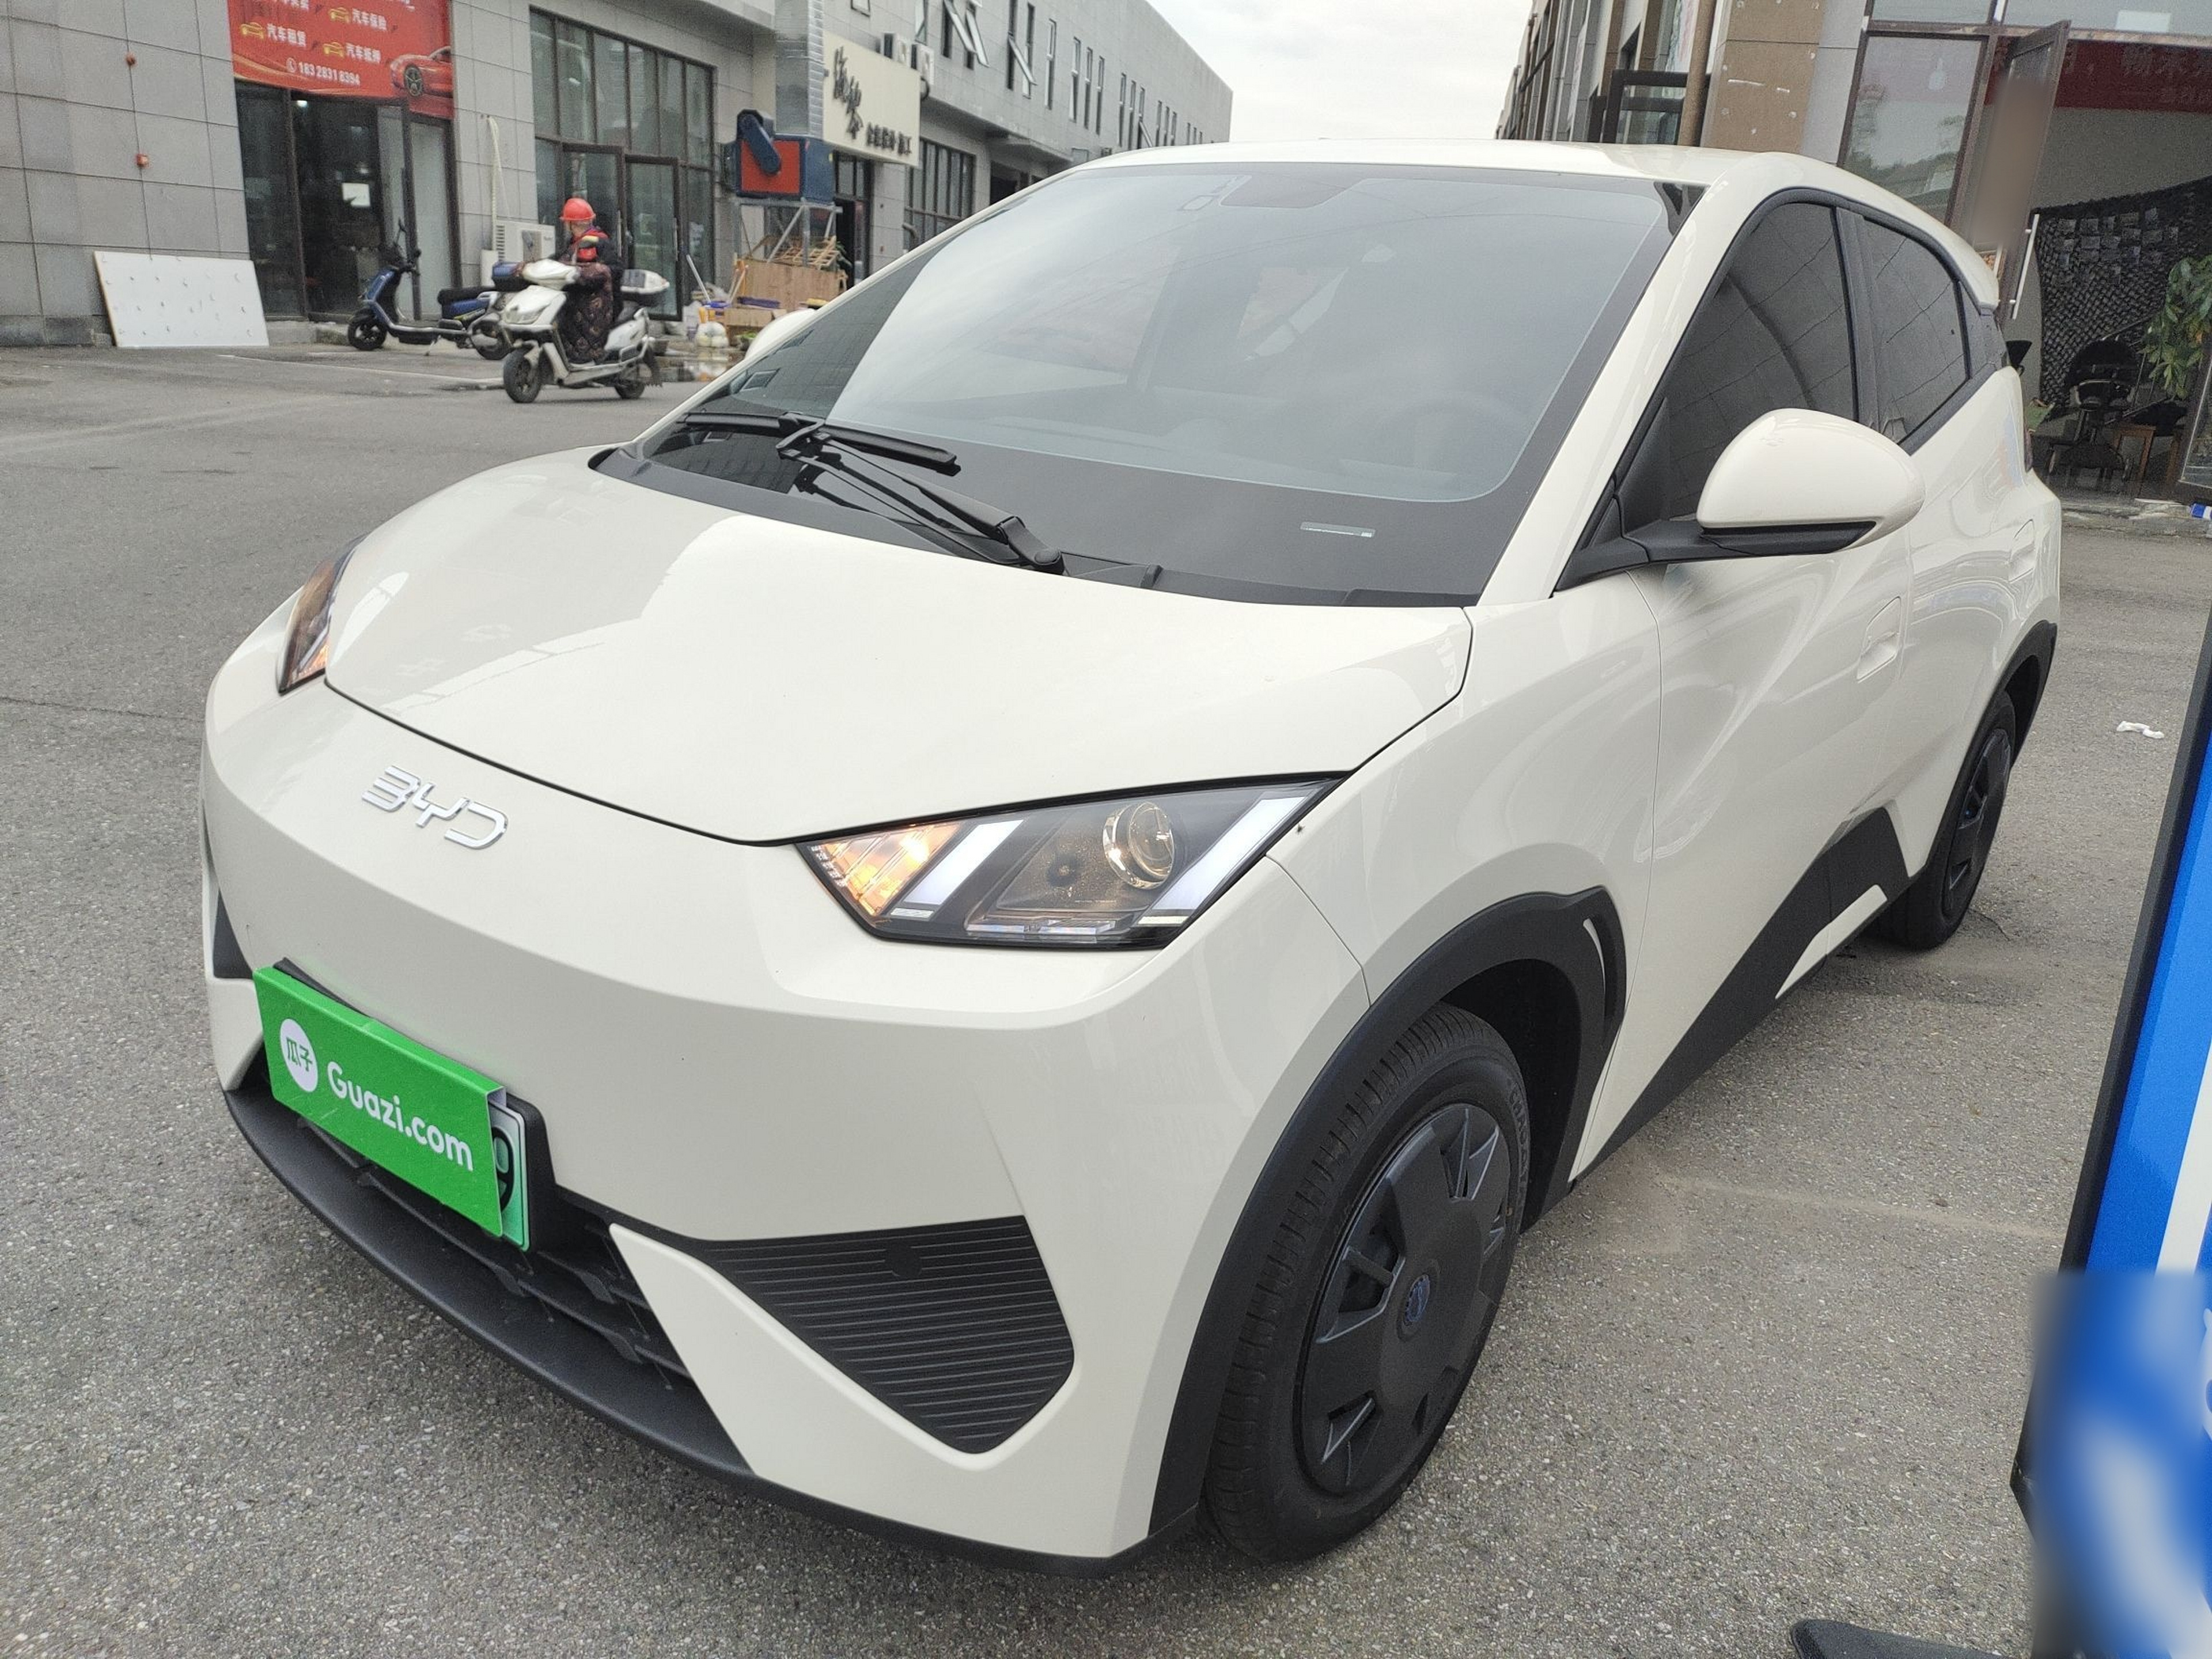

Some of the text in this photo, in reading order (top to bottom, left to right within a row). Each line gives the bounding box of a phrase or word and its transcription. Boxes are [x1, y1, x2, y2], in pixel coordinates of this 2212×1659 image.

[361, 765, 508, 850] BYD
[286, 1037, 313, 1072] 瓜子
[327, 1061, 474, 1172] Guazi.com
